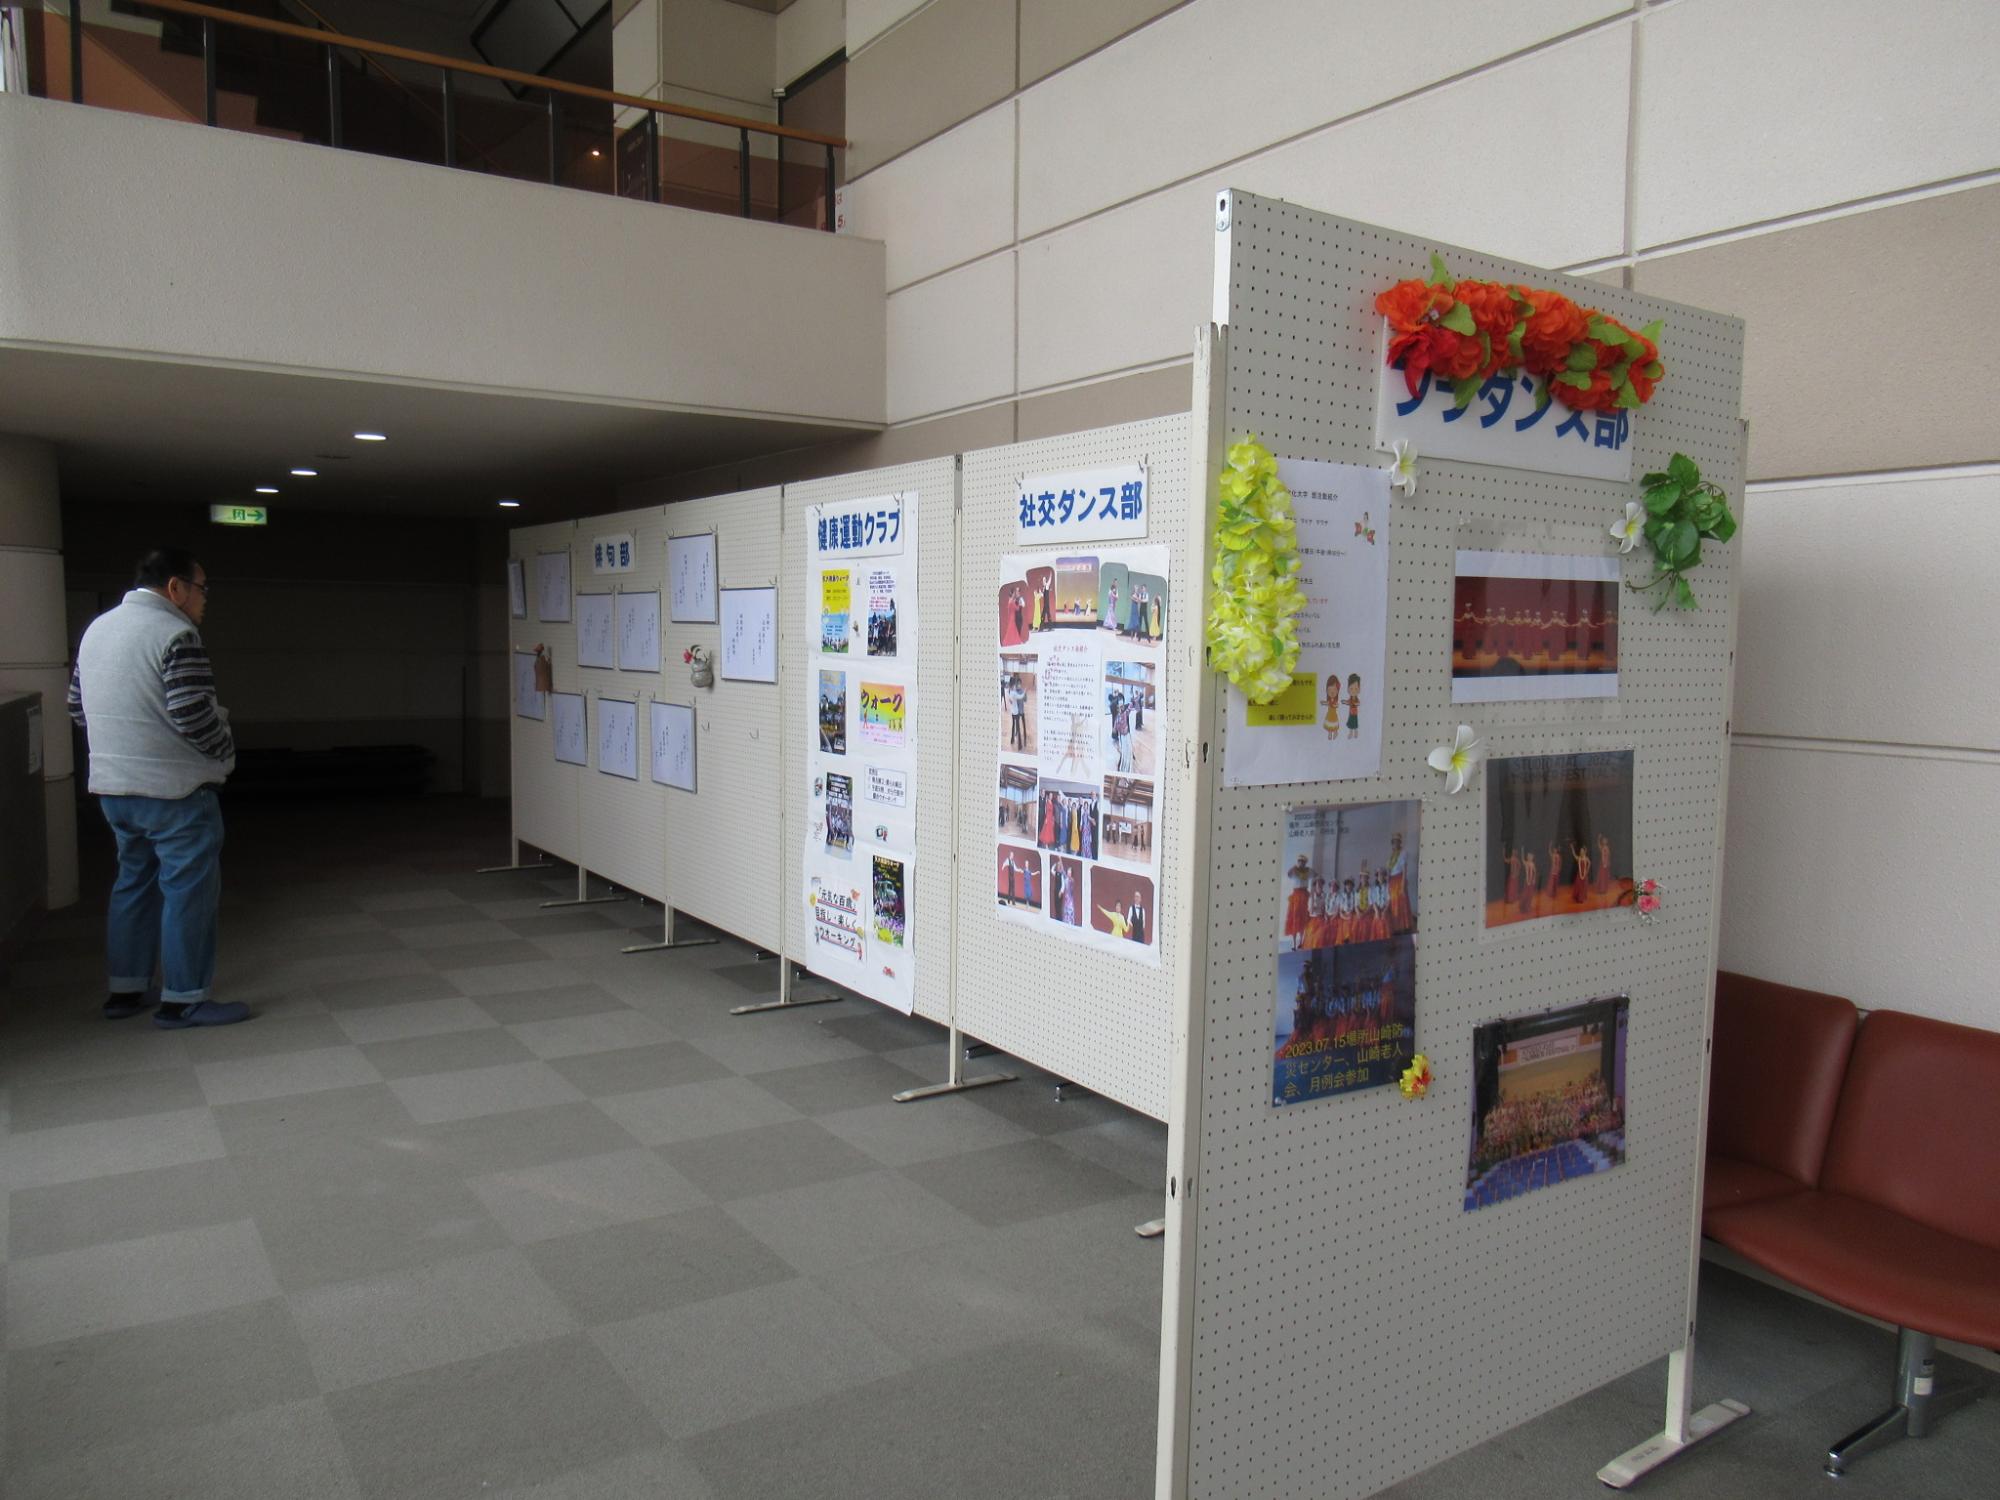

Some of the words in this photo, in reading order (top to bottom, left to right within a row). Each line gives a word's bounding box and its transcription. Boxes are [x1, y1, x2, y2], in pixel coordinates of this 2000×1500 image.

[1019, 480, 1144, 530] 社交ダンス部
[817, 510, 901, 552] 健康運動クラブ
[594, 540, 632, 569] 俳句部
[860, 688, 903, 713] ウォーク
